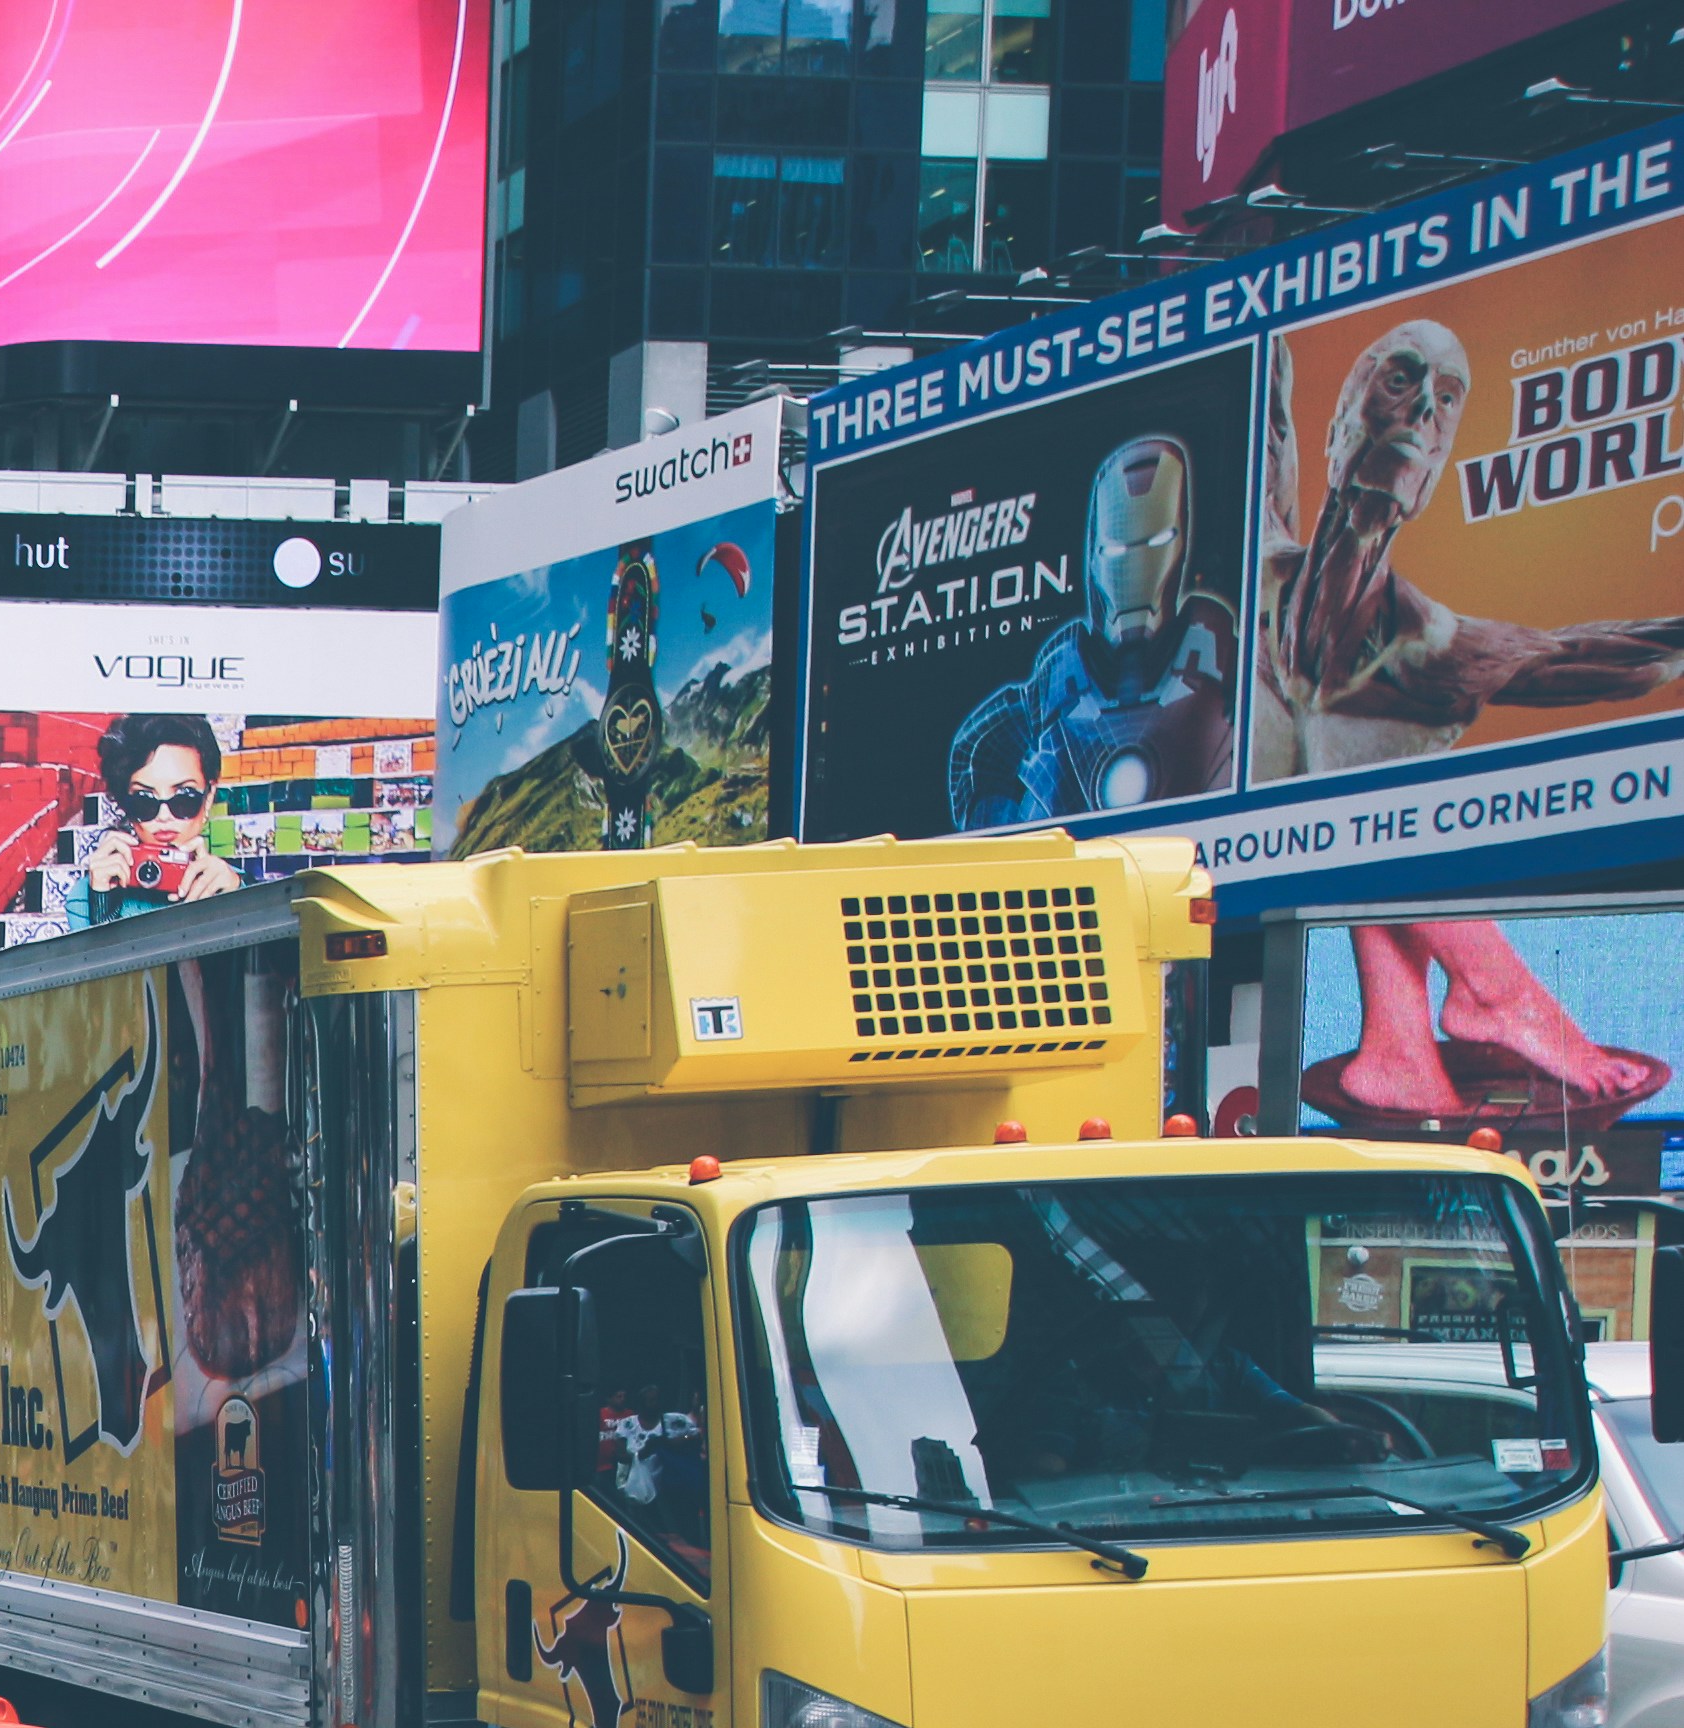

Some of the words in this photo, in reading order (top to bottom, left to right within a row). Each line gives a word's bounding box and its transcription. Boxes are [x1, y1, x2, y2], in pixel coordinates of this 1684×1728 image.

[1195, 6, 1238, 182] lyft
[813, 368, 944, 451] THREE
[957, 298, 1187, 403] MUST-SEE
[1202, 210, 1451, 335] EXHIBITS
[1470, 184, 1528, 256] IN
[1549, 138, 1676, 225] THE
[1509, 331, 1599, 371] Gunther
[1606, 317, 1647, 343] von
[1517, 334, 1684, 441] BOD
[614, 436, 732, 504] swatch
[15, 533, 70, 570] hut
[875, 492, 1036, 593] AVENGERS
[869, 614, 1034, 667] EXHIBITION
[92, 653, 246, 688] VOGUE
[1190, 818, 1336, 874] AROUND
[1349, 807, 1419, 850] THE
[1432, 776, 1596, 837] CORNER
[1610, 764, 1672, 807] ON
[0, 1364, 56, 1455] Inc.
[11, 1475, 60, 1519] Hanging
[61, 1483, 98, 1516] Prime
[100, 1487, 130, 1521] Beef
[214, 1500, 242, 1522] ANGUS
[242, 1497, 261, 1517] BEEF
[216, 1475, 259, 1501] CERTIFIED
[55, 1540, 75, 1578] the
